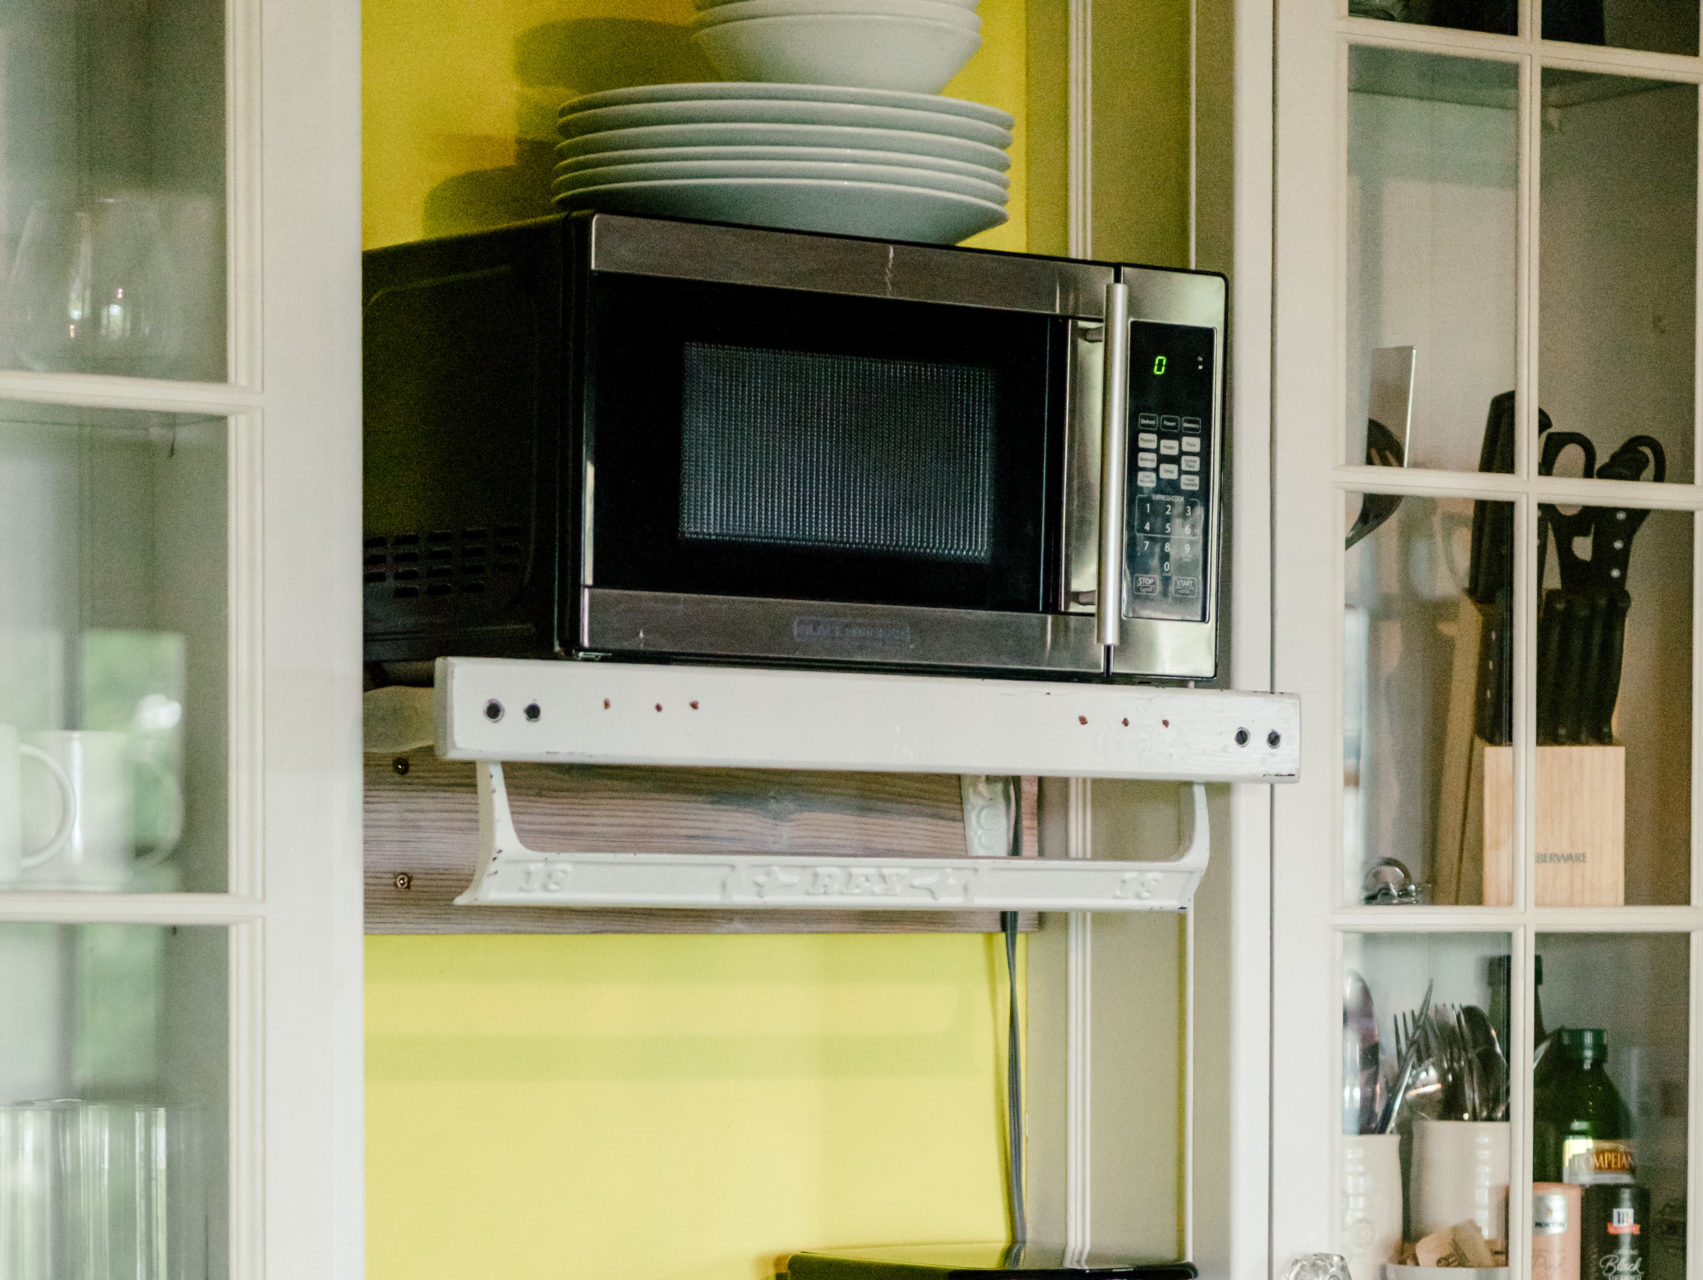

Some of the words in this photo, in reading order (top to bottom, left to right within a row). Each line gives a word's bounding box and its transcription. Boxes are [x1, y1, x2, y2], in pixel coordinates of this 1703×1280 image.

[1153, 355, 1167, 375] 0
[1146, 503, 1150, 513] 1
[1166, 504, 1171, 515] 2
[1186, 505, 1191, 516] 3
[1144, 521, 1150, 532] 4
[1165, 523, 1171, 533] 5
[1184, 525, 1191, 535] 6
[1143, 540, 1149, 551] 7
[1164, 542, 1171, 553] 8
[1184, 543, 1191, 554] 9
[1163, 561, 1170, 572] 0
[1138, 577, 1154, 586] STOP
[1177, 579, 1193, 588] START
[1535, 852, 1587, 864] BERWARE
[1599, 1254, 1644, 1277] Black
